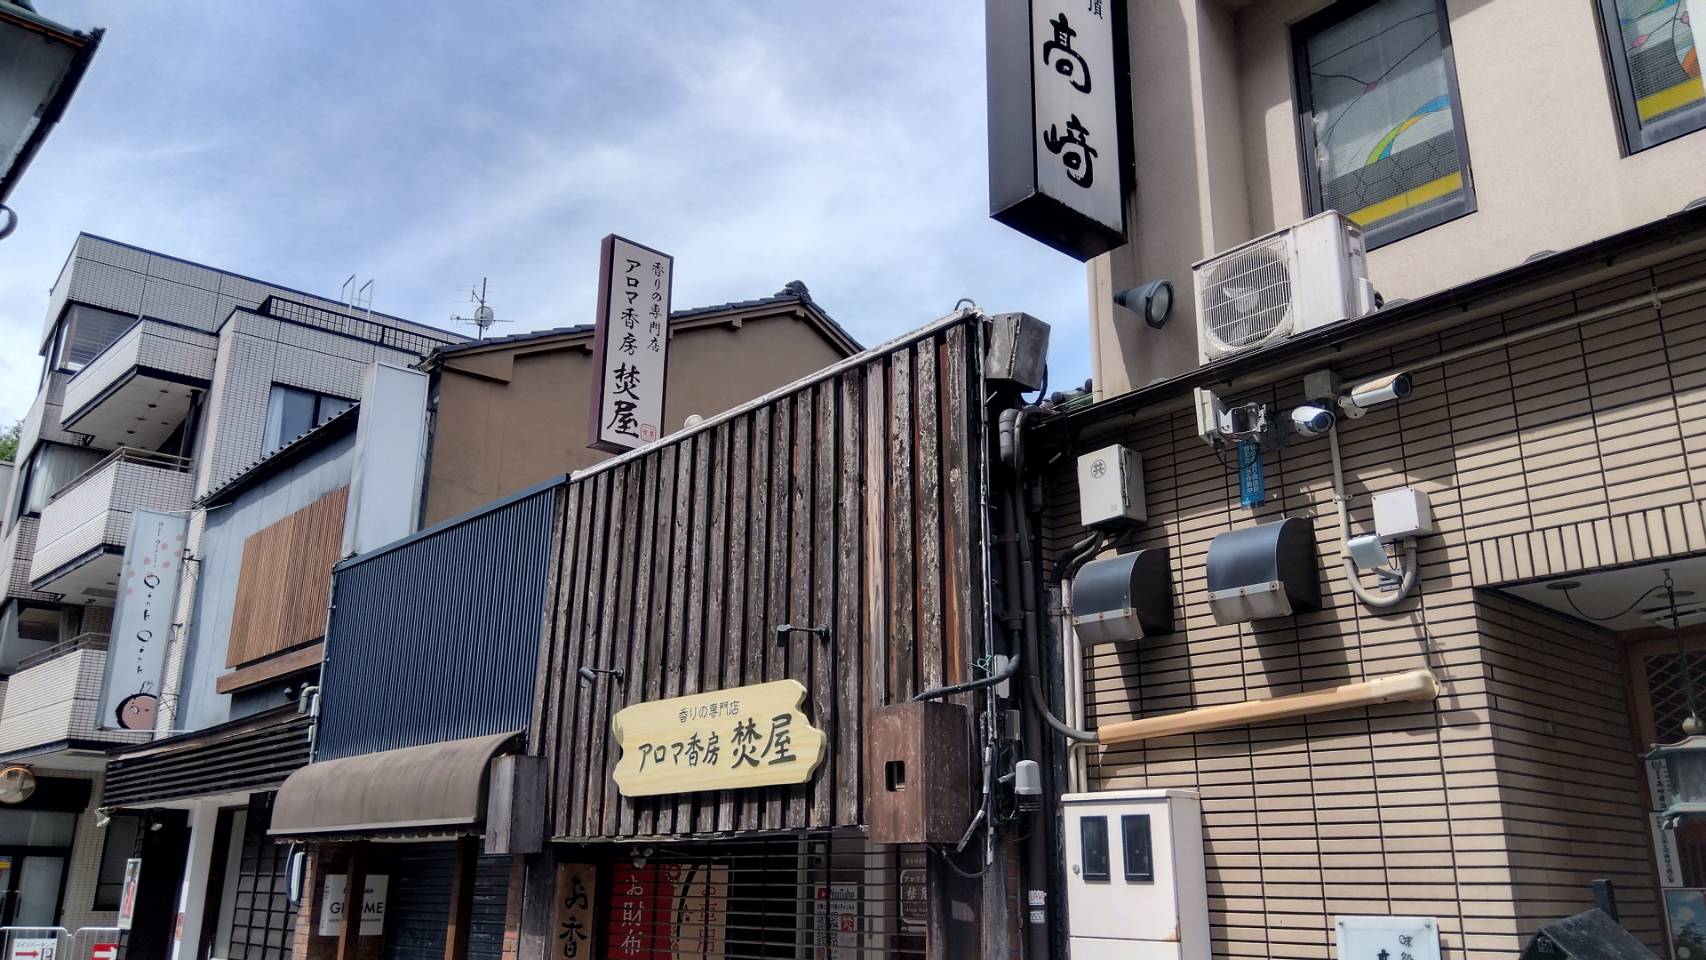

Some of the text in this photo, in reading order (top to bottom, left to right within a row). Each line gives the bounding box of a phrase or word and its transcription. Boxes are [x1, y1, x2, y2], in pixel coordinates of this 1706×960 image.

[646, 262, 665, 353] 香りの専門店
[638, 713, 797, 773] アロマ香房 焚屋
[678, 700, 740, 723] 香りの専門店
[558, 876, 589, 959] お香
[620, 874, 644, 956] お財布
